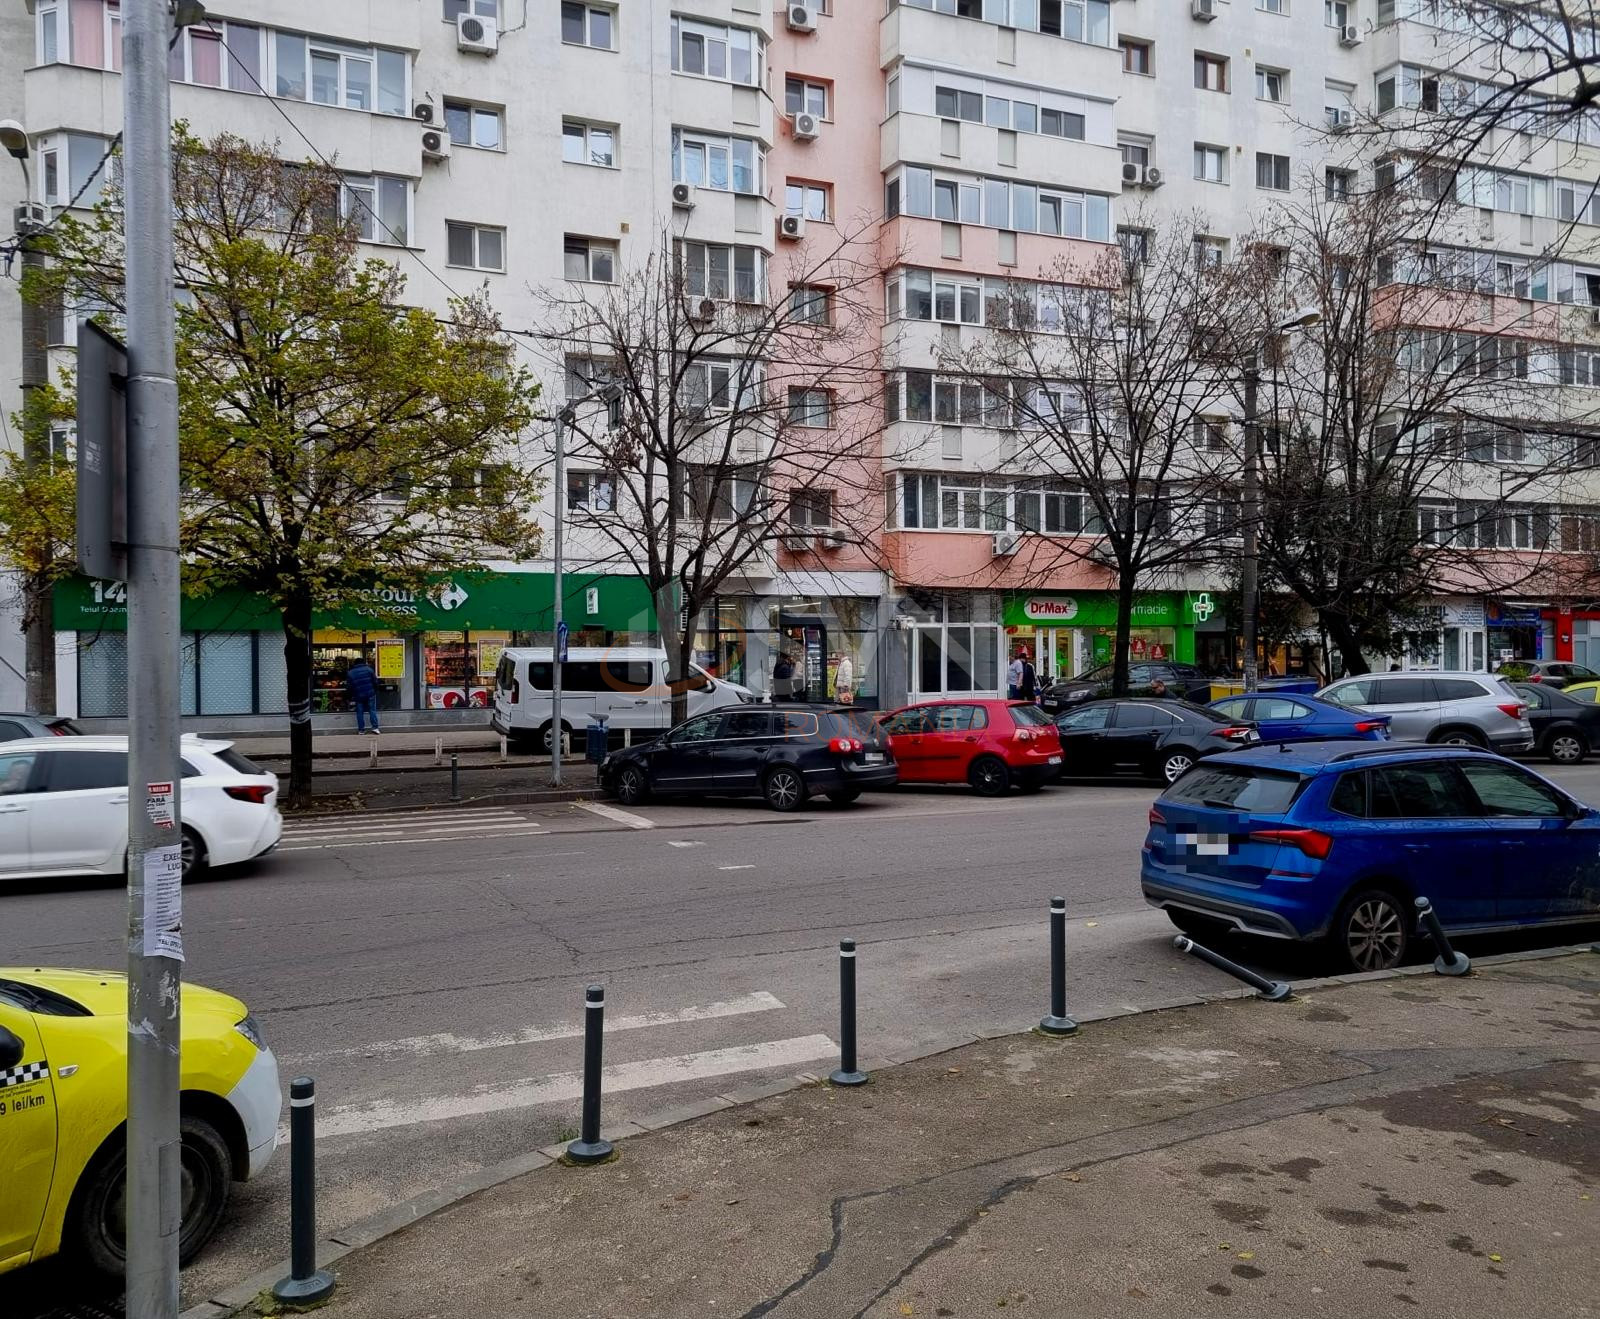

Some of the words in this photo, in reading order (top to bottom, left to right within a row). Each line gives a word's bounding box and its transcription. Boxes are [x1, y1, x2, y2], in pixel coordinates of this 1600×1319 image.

[80, 605, 100, 613] Teiul
[1030, 602, 1068, 614] Dr.Max
[1131, 603, 1168, 615] rmacie
[163, 852, 181, 861] EXEC
[12, 1095, 45, 1112] lei/km
